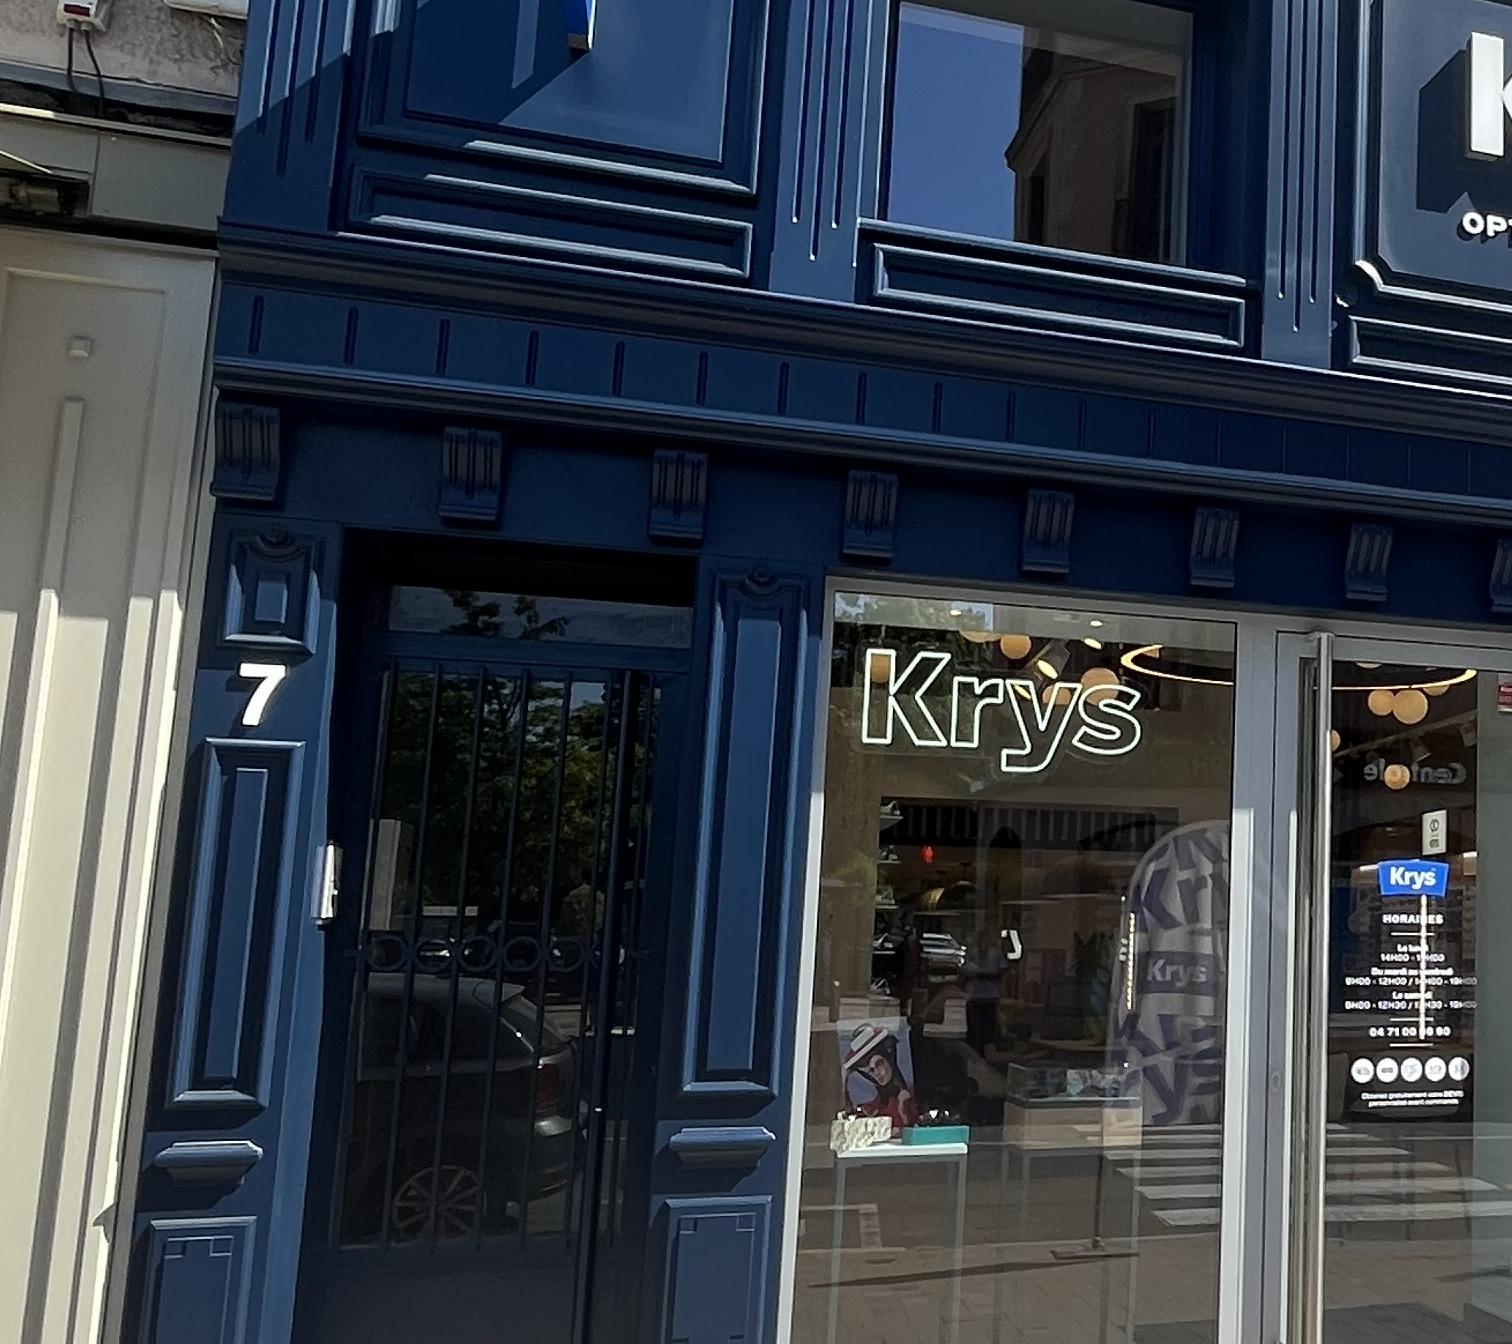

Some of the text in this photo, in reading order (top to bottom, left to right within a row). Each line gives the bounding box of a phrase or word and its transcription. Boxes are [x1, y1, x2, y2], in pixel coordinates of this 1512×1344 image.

[239, 662, 287, 726] 7
[861, 648, 1142, 772] Krys
[1390, 866, 1437, 890] Krys
[1382, 914, 1444, 925] HORAIES
